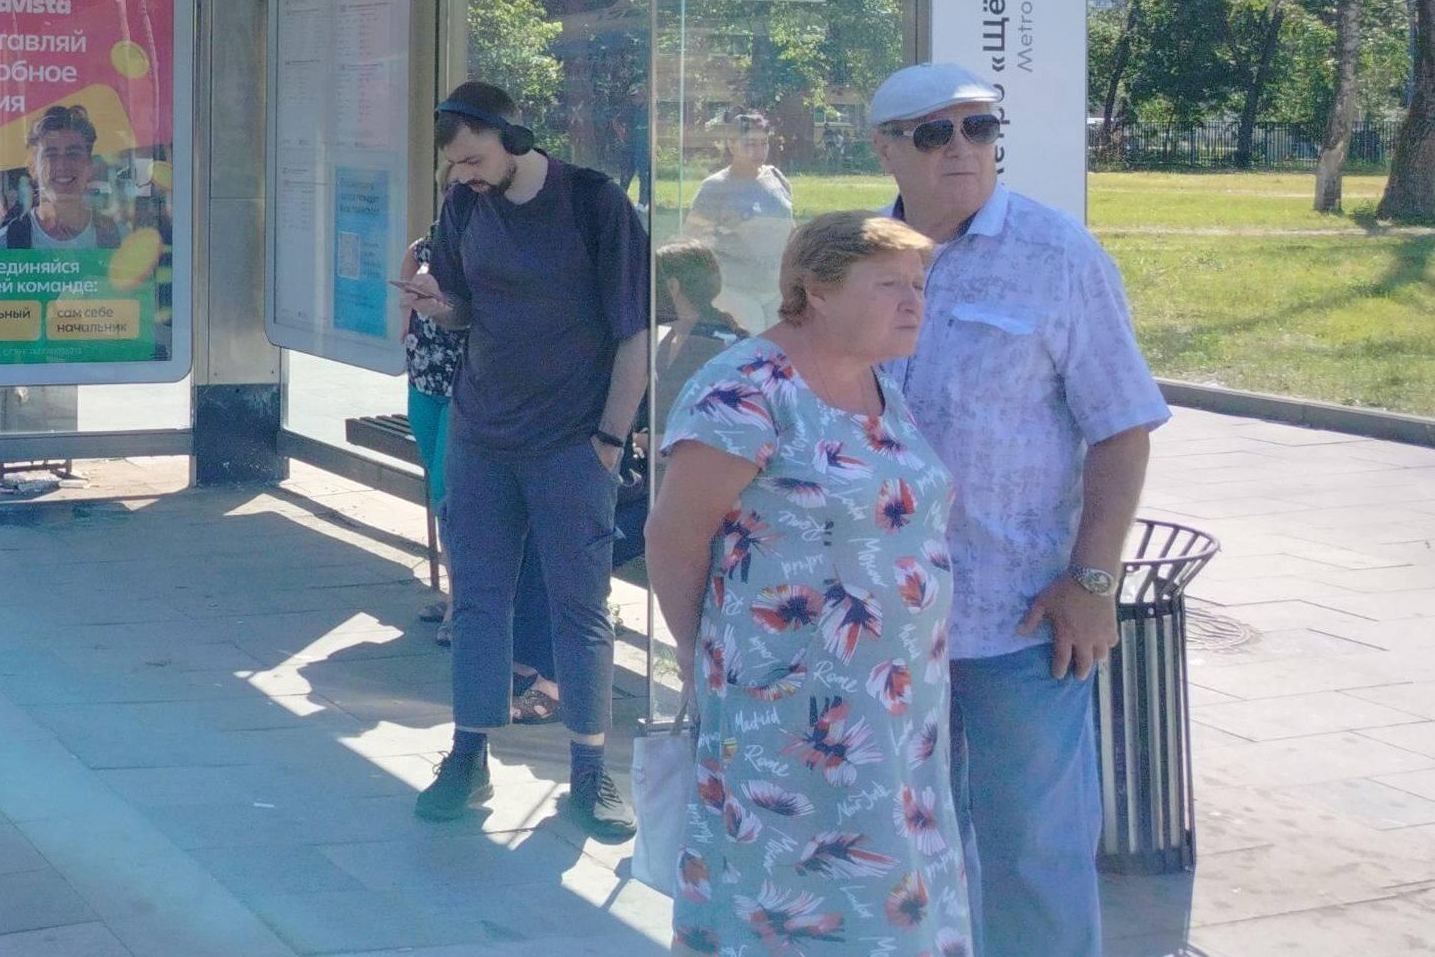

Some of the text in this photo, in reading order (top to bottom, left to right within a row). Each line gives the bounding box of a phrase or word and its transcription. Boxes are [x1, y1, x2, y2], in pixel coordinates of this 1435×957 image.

[1017, 0, 1034, 73] Metro
[16, 280, 99, 295] команде:
[57, 307, 114, 319] сам себе
[56, 322, 128, 334] начальник
[813, 660, 859, 693] Rome
[734, 705, 781, 733] Madrid
[743, 744, 790, 778] Rome
